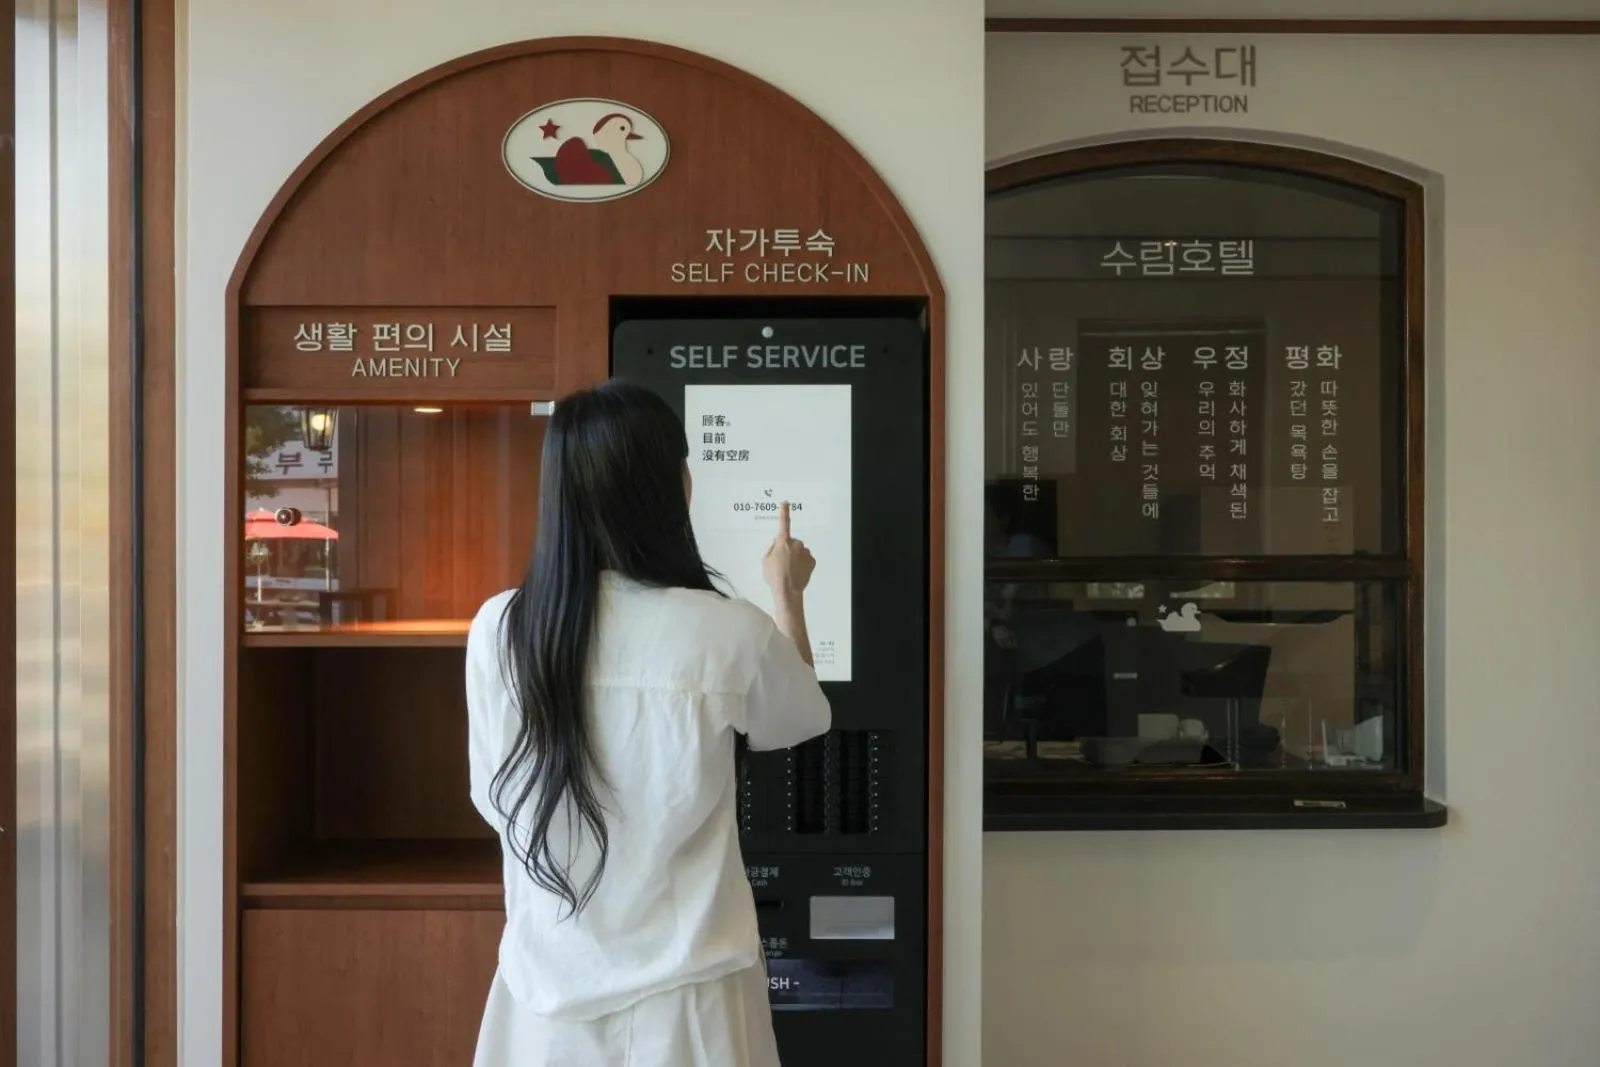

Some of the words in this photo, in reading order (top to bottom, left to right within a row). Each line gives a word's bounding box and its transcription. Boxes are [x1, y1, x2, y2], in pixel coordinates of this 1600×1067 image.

[1120, 45, 1256, 87] 접수대
[1130, 95, 1248, 113] RECEPTION
[705, 227, 835, 257] 자가투숙
[1101, 240, 1254, 276] 수림호텔
[671, 263, 735, 283] SELF
[744, 263, 870, 283] CHECK-IN
[293, 323, 357, 352] 생활
[372, 323, 433, 352] 편의
[450, 323, 512, 352] 시설
[352, 357, 461, 377] AMENITY
[670, 345, 738, 368] SELF
[747, 345, 866, 368] SERVICE
[1017, 346, 1074, 372] 사랑
[1107, 346, 1165, 371] 회상
[1193, 346, 1248, 370] 우정
[1285, 345, 1343, 370] 평화
[1022, 382, 1038, 437] 있어도
[1110, 381, 1127, 418] 대한
[1198, 382, 1216, 437] 우리의
[1321, 381, 1339, 435] 따뜻한
[702, 415, 731, 427] 顾客。
[1228, 381, 1247, 456] 화사하게
[703, 433, 726, 444] 目前
[1110, 425, 1128, 462] 회상
[1290, 425, 1308, 480] 목욕탕
[702, 450, 750, 462] 没有空房
[1321, 444, 1339, 479] 손을
[1021, 445, 1040, 502] 행복한
[1141, 464, 1159, 519] 것들에
[1322, 488, 1339, 522] 잡고
[733, 502, 802, 511] 010-7609-84
[747, 866, 779, 877] 금결제
[833, 866, 871, 877] 고객인증
